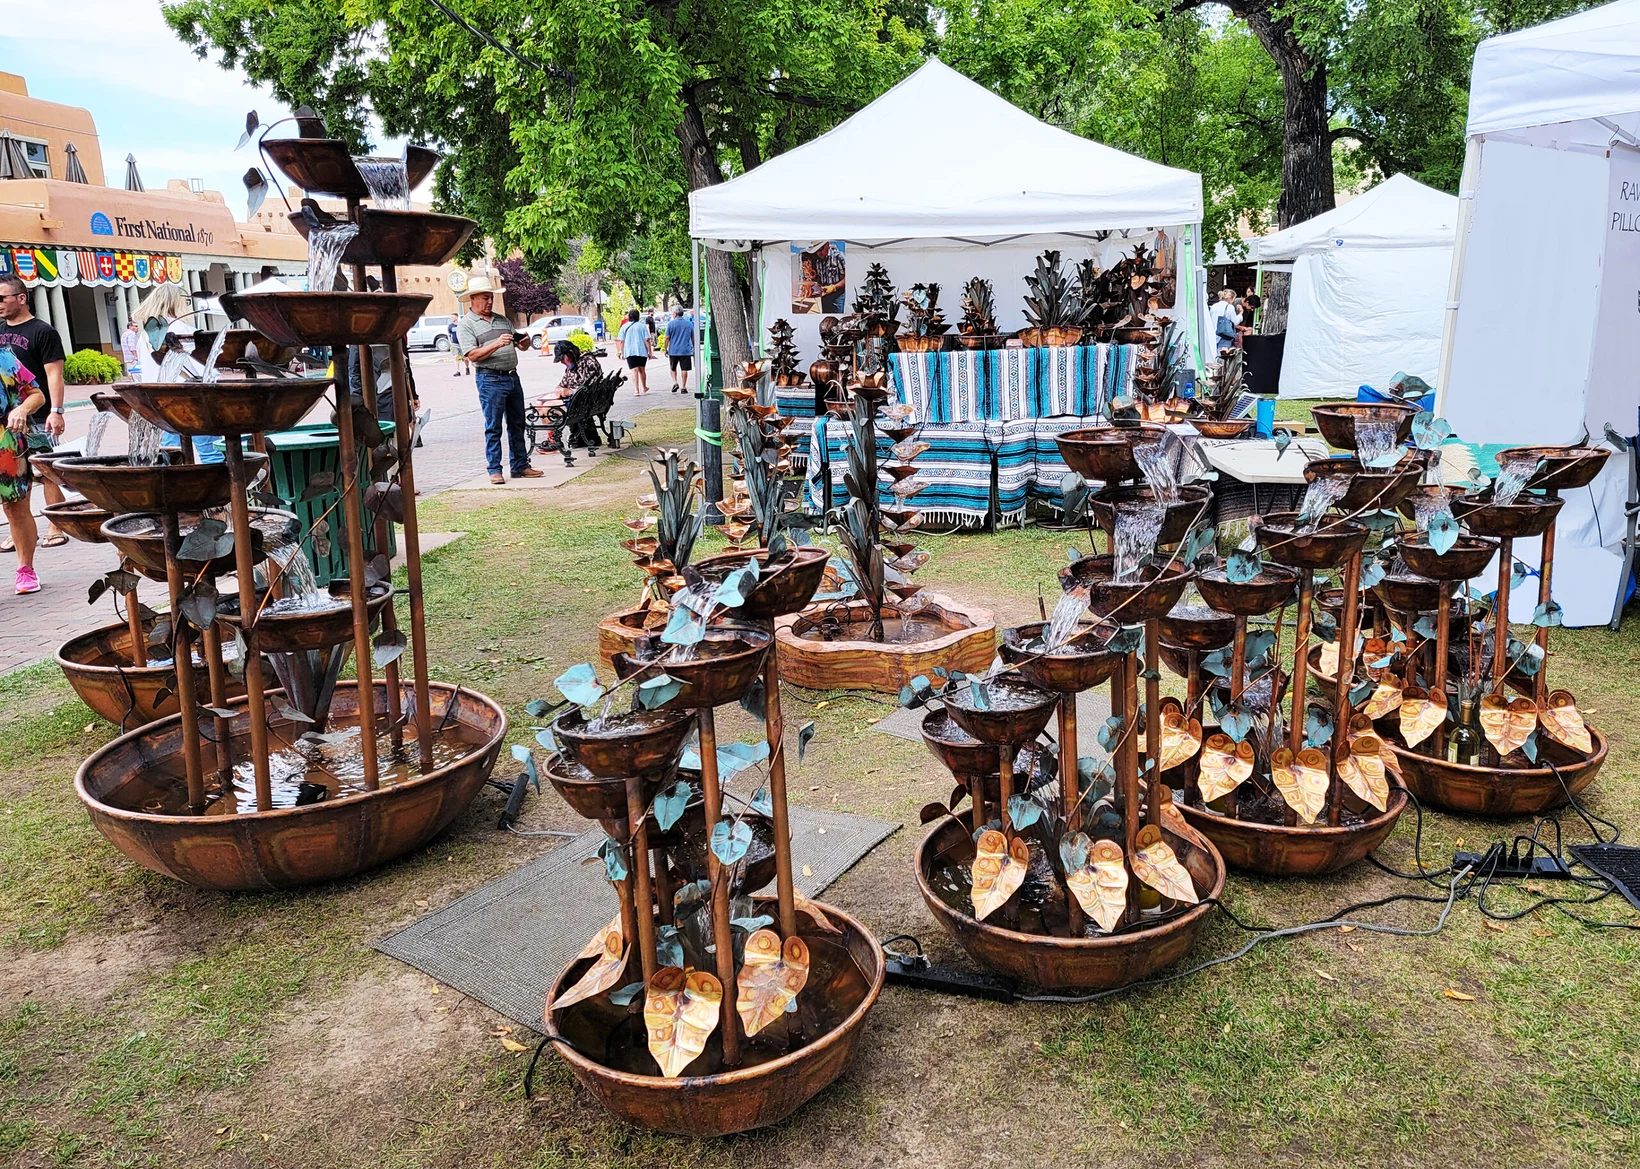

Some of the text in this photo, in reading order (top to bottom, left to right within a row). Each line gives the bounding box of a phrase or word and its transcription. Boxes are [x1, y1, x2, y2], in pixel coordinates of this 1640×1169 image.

[1620, 181, 1640, 201] RA
[114, 216, 214, 246] First National 1870
